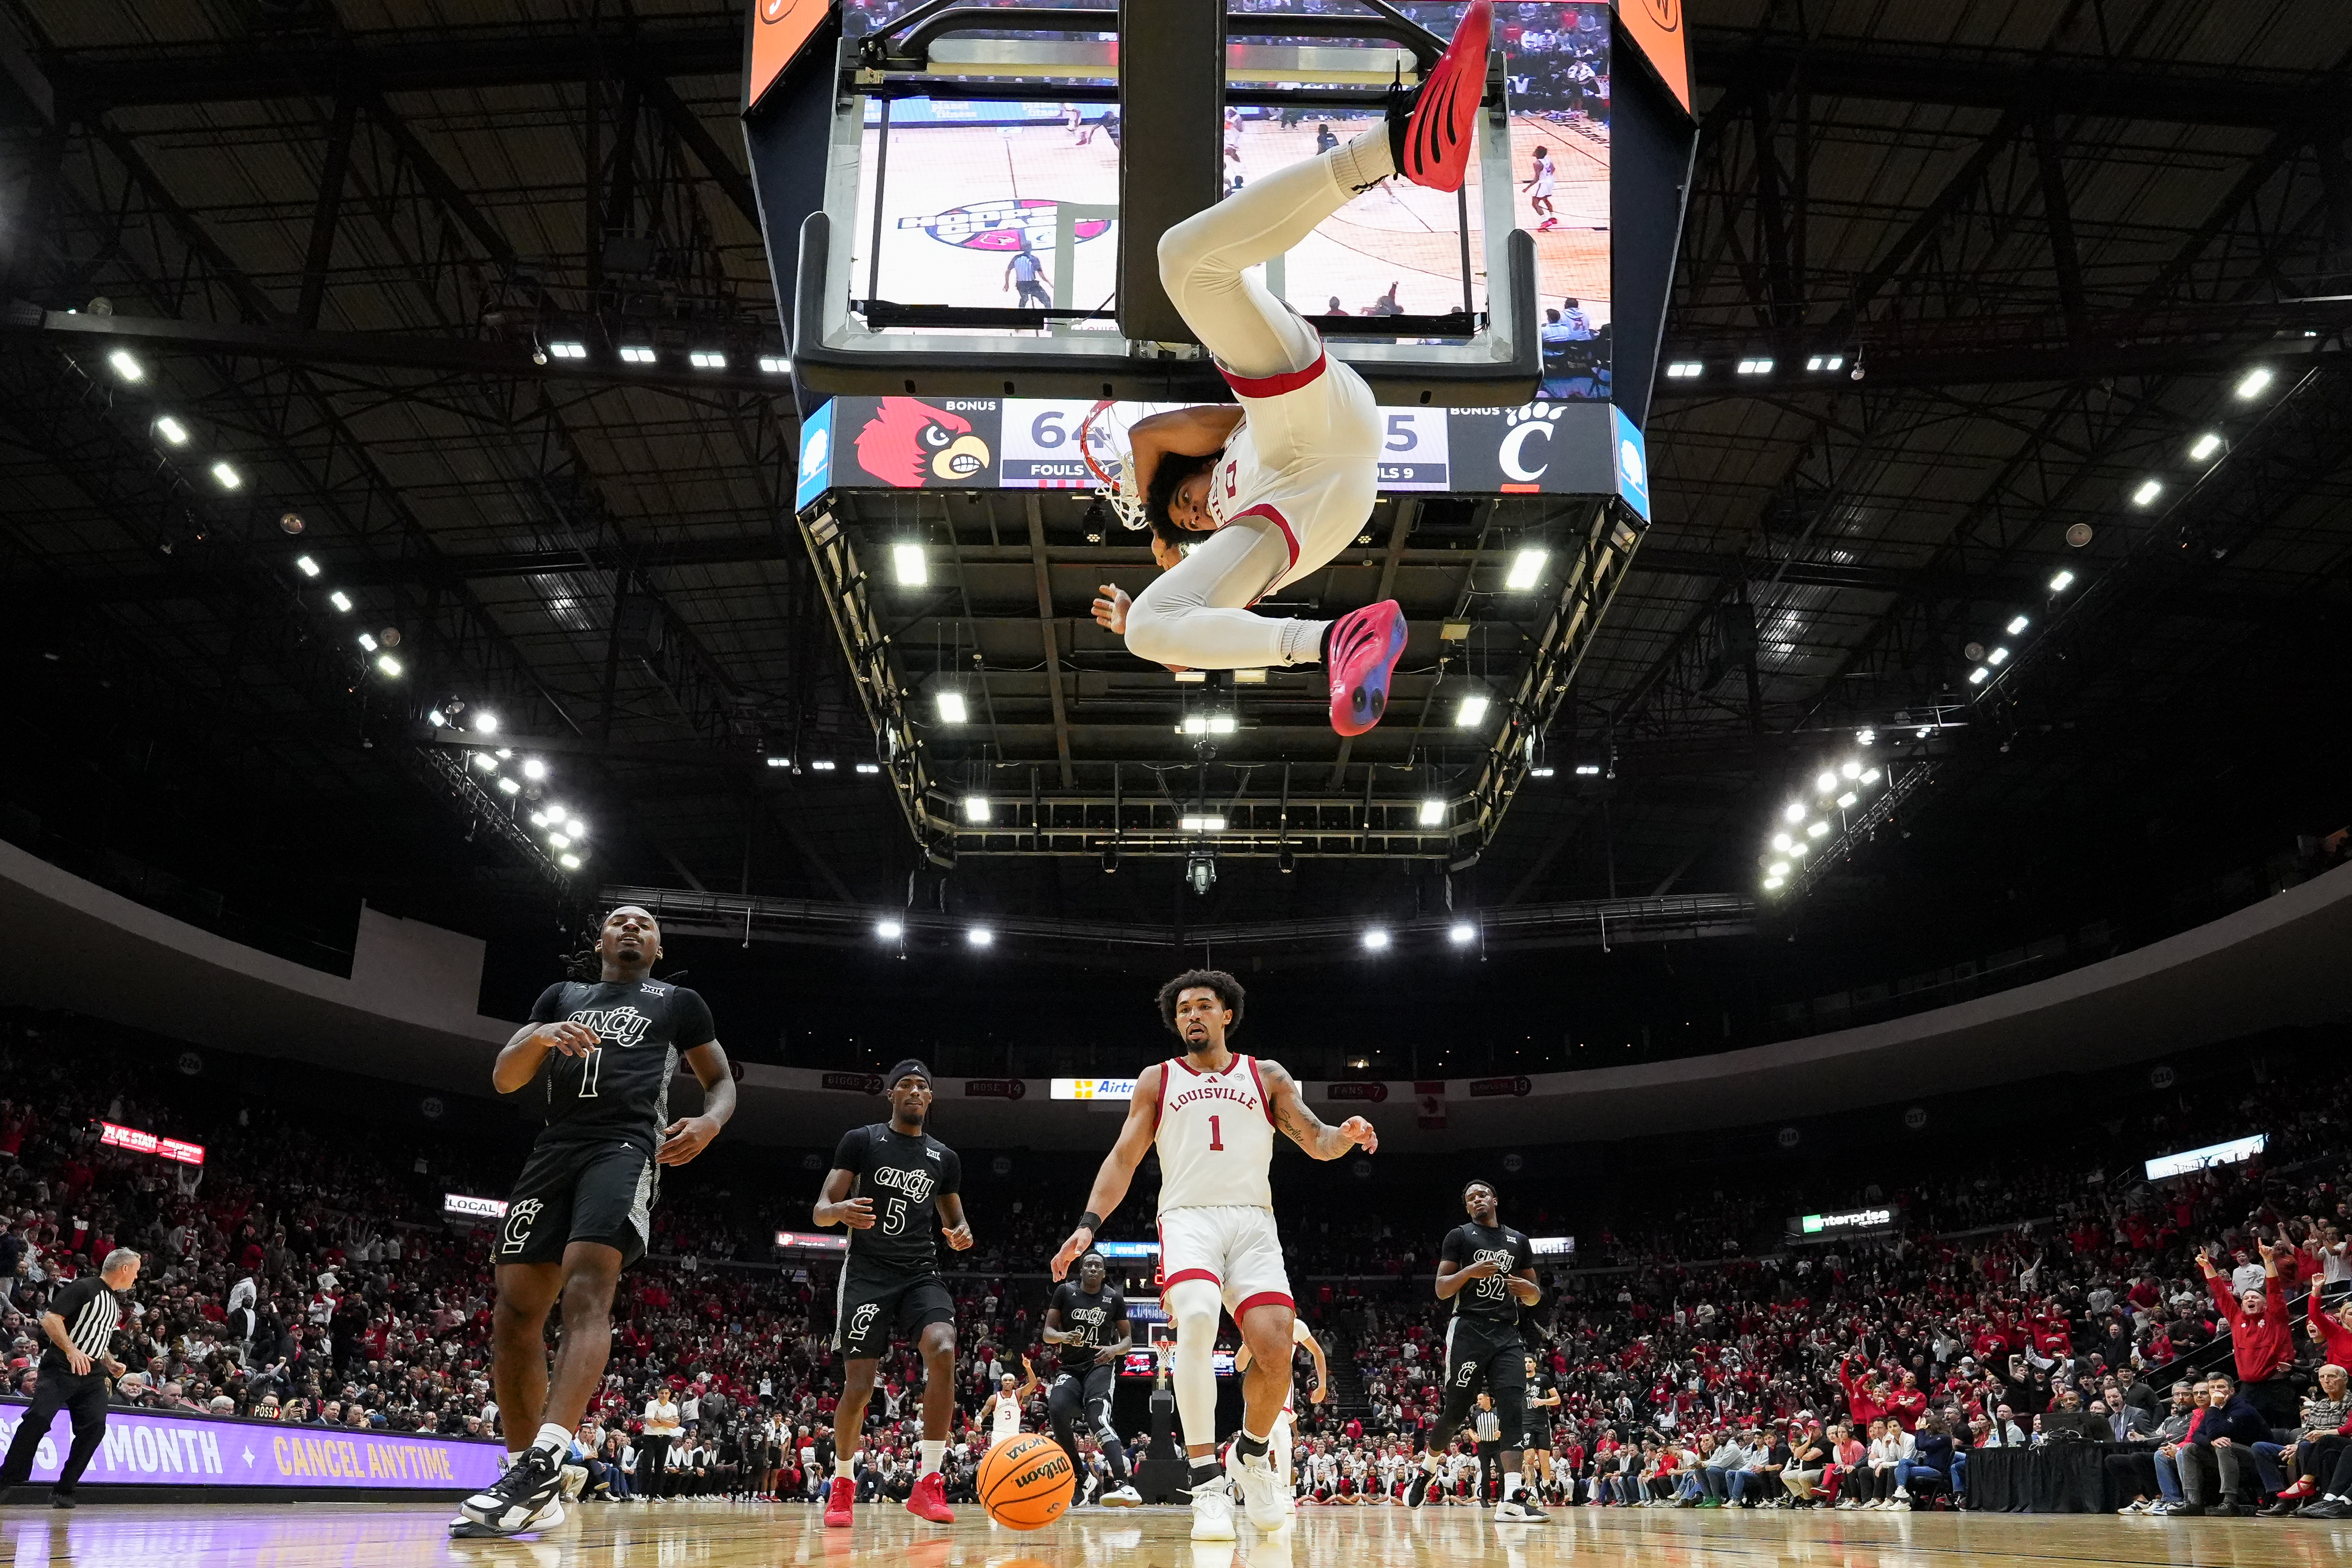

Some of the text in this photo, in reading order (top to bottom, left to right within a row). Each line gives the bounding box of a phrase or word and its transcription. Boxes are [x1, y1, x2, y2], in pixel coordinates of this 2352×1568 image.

[946, 401, 996, 411] BONUS
[1031, 411, 1111, 448] 64
[1031, 464, 1084, 476] FOULS
[1403, 468, 1414, 479] 9
[579, 1047, 602, 1098] 1
[864, 1078, 881, 1090] 22
[974, 1083, 1022, 1094] ROSE 14
[1335, 1086, 1381, 1097] FANS 7
[1513, 1080, 1528, 1092] 13
[1170, 1088, 1257, 1112] LOUISVILLE
[1209, 1115, 1224, 1151] 1
[875, 1167, 934, 1203] CINCY
[449, 1199, 496, 1213] LOCAL
[883, 1197, 907, 1235] 5
[1809, 1210, 1890, 1227] nterprise
[1474, 1249, 1514, 1273] CINCY
[1477, 1274, 1505, 1301] 32
[1072, 1307, 1106, 1327] CINCY
[1072, 1325, 1100, 1349] 24
[1005, 1410, 1011, 1420] 3
[101, 1423, 223, 1474] MONTH
[753, 1440, 759, 1449] 7
[1006, 1437, 1048, 1460] NCAA
[273, 1436, 454, 1480] CANCEL ANYTIME
[1015, 1456, 1071, 1488] Wilson
